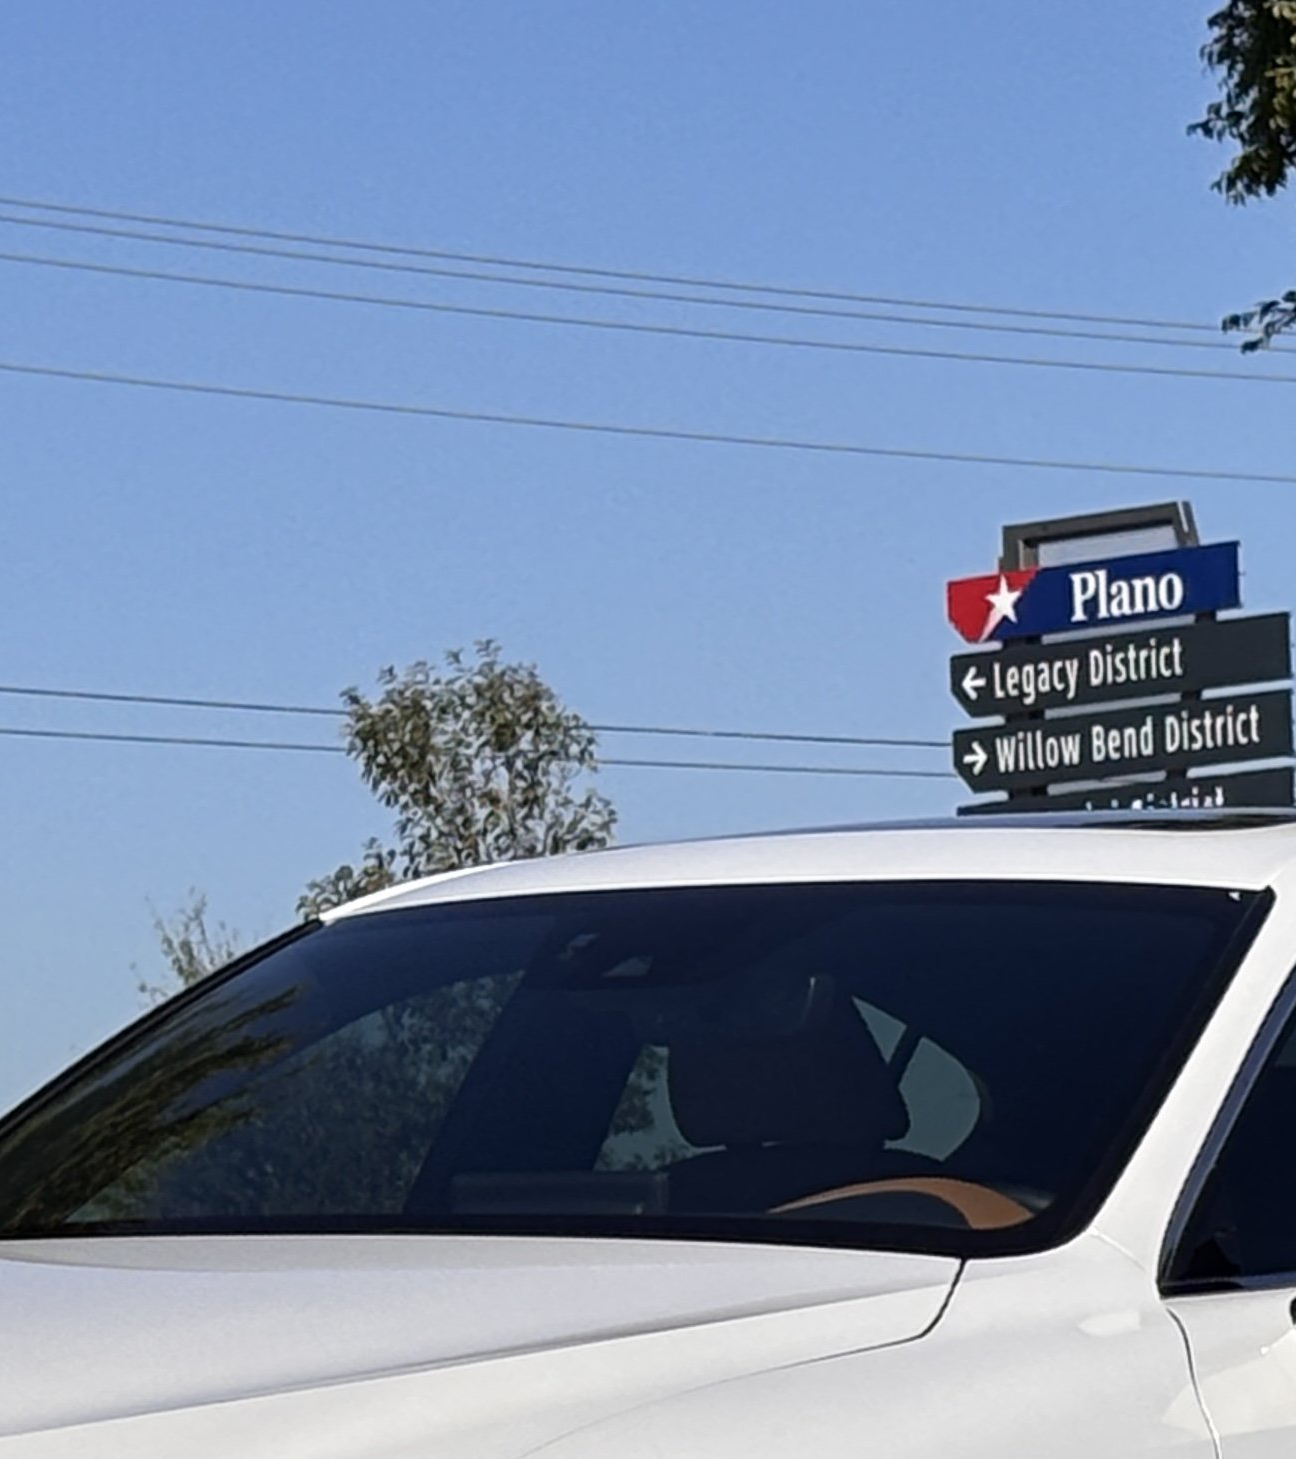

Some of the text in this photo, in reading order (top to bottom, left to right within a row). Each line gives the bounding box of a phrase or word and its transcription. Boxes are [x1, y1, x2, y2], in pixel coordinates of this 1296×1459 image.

[1069, 569, 1184, 622] Plano
[993, 638, 1183, 705] Legacy District
[996, 705, 1260, 773] Willow Bend District
